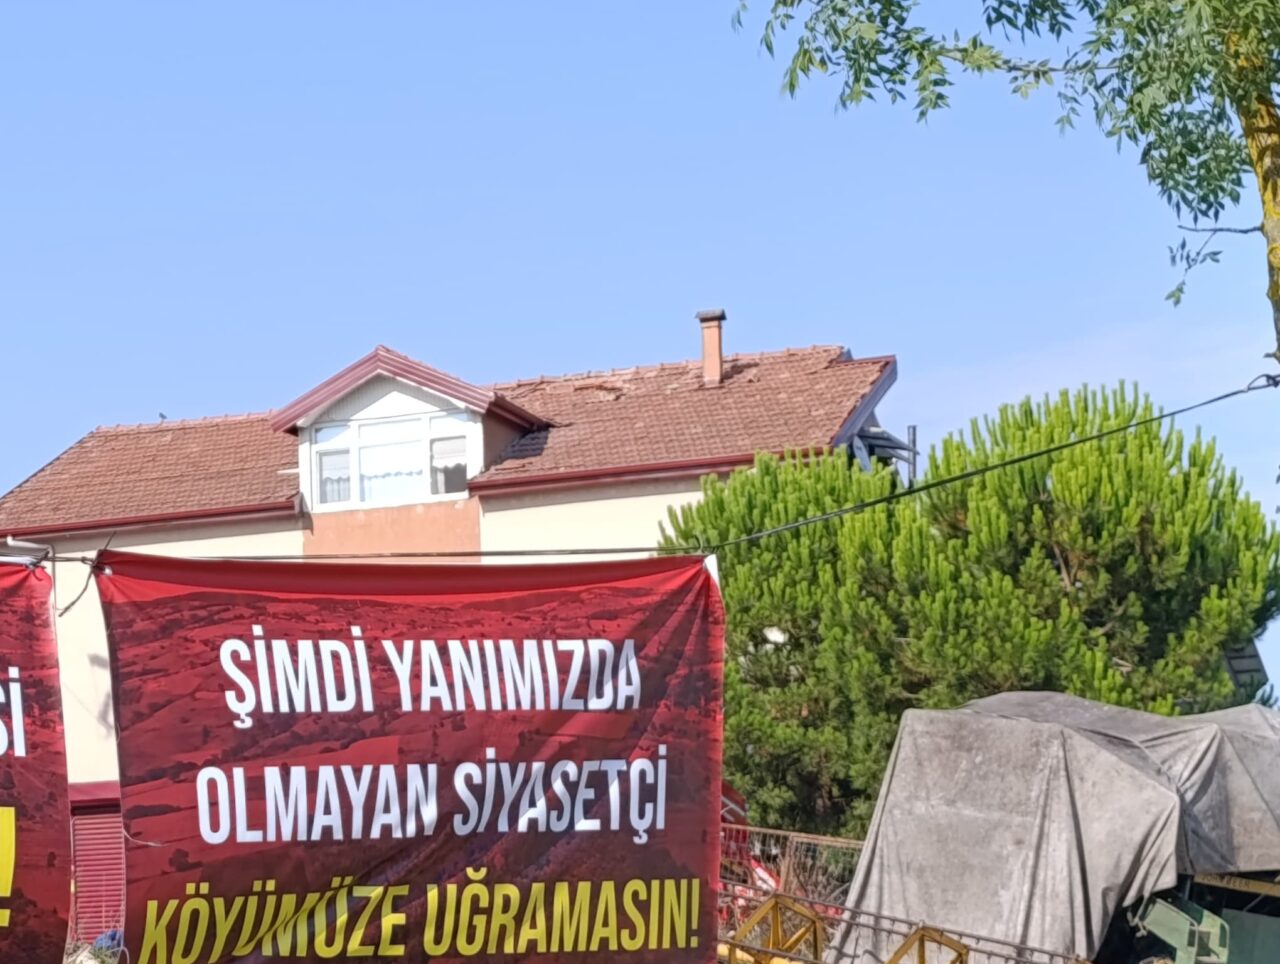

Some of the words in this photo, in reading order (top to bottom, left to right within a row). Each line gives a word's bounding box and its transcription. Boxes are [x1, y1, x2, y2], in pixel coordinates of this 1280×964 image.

[220, 624, 375, 729] ŞİMDİ
[381, 638, 642, 713] YANIMIZDA
[195, 762, 438, 845] OLMAYAN
[452, 743, 668, 845] SİYASETÇİ
[422, 866, 701, 957] UĞRAMASIN!
